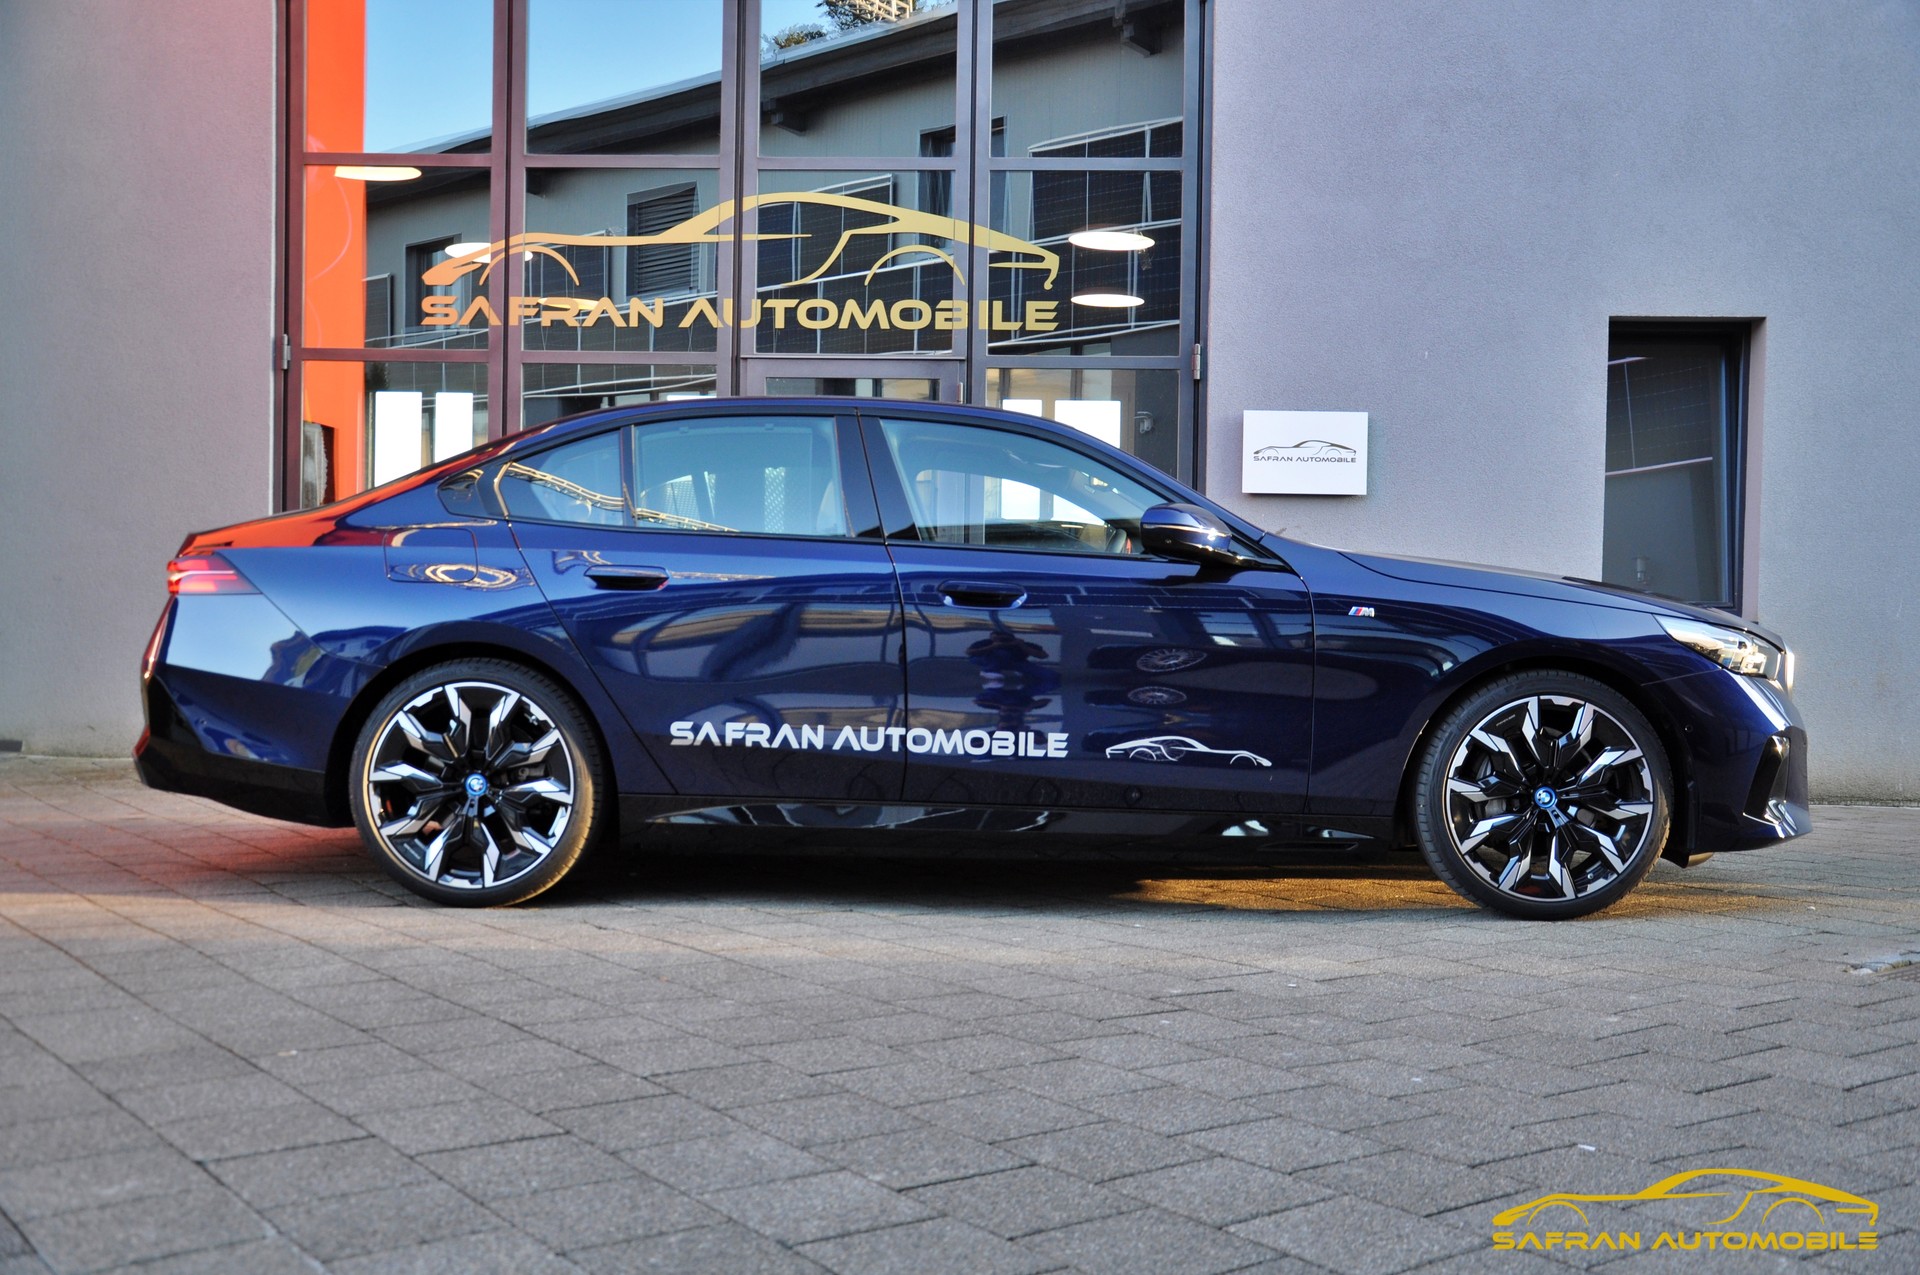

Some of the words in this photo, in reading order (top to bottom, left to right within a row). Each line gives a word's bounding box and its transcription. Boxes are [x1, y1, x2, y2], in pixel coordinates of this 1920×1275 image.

[420, 296, 662, 328] SAFRAN
[679, 298, 1058, 331] AUTOMOBILE
[670, 721, 824, 750] SAFRAN
[833, 726, 1069, 758] AUTOMOBILE
